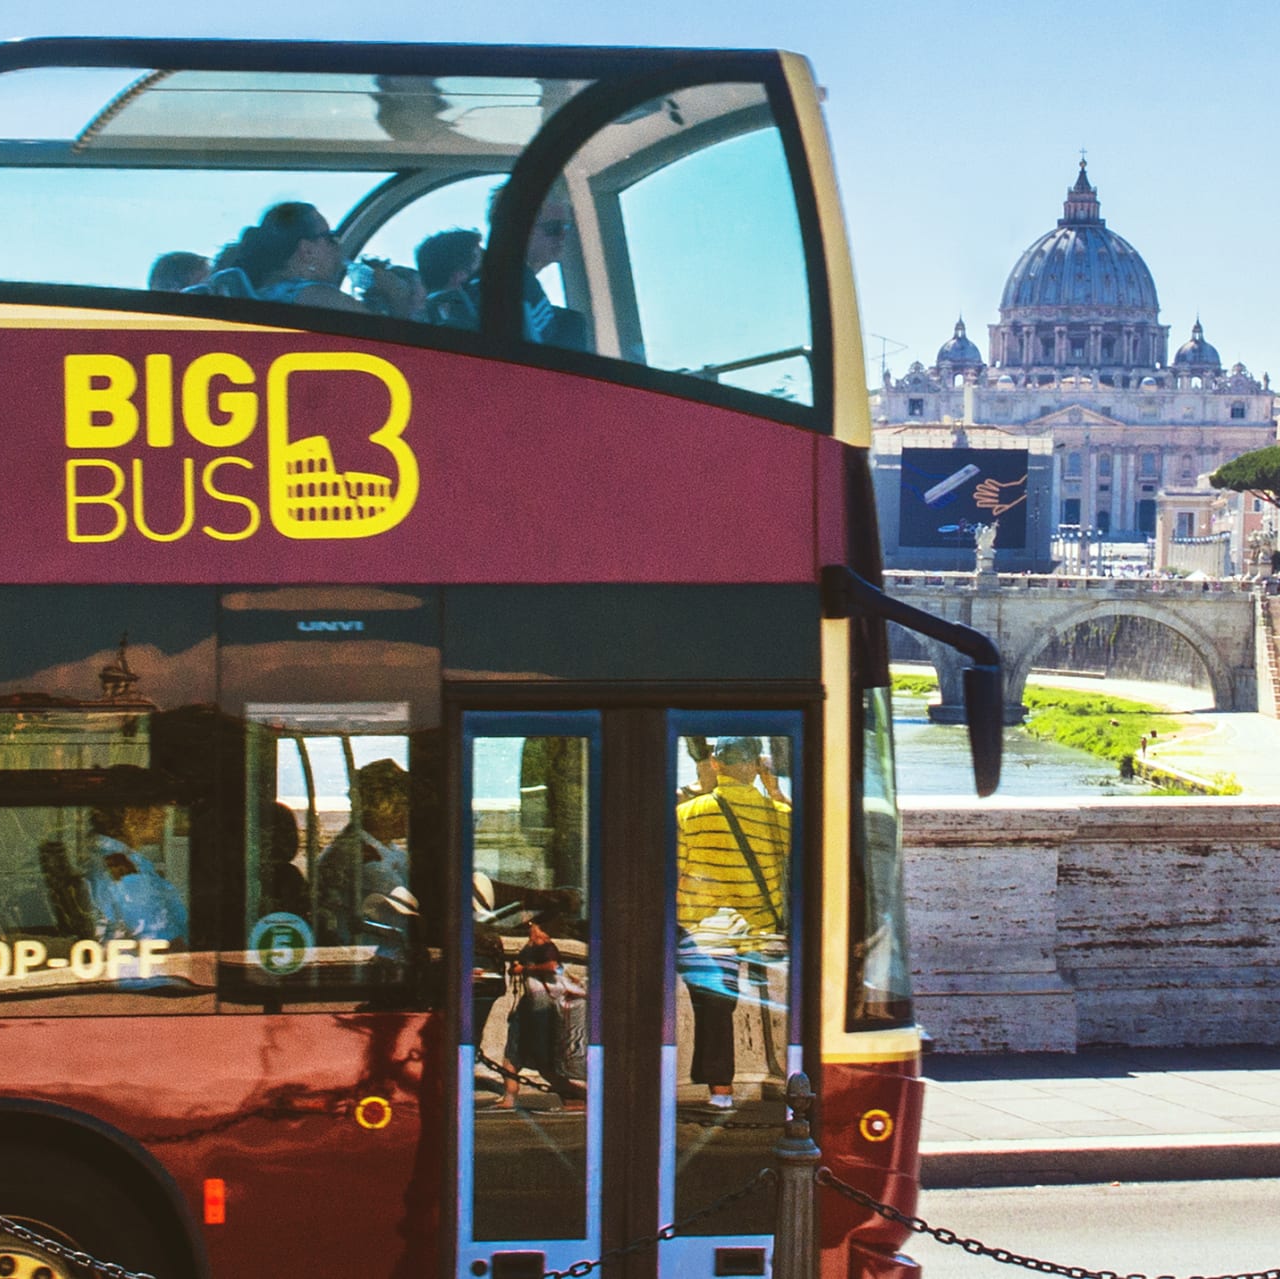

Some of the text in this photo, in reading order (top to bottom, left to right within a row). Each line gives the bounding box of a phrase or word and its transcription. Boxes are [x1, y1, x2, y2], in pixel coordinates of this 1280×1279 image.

[64, 352, 259, 449] BIG
[65, 455, 261, 543] BUS
[270, 926, 294, 967] 5
